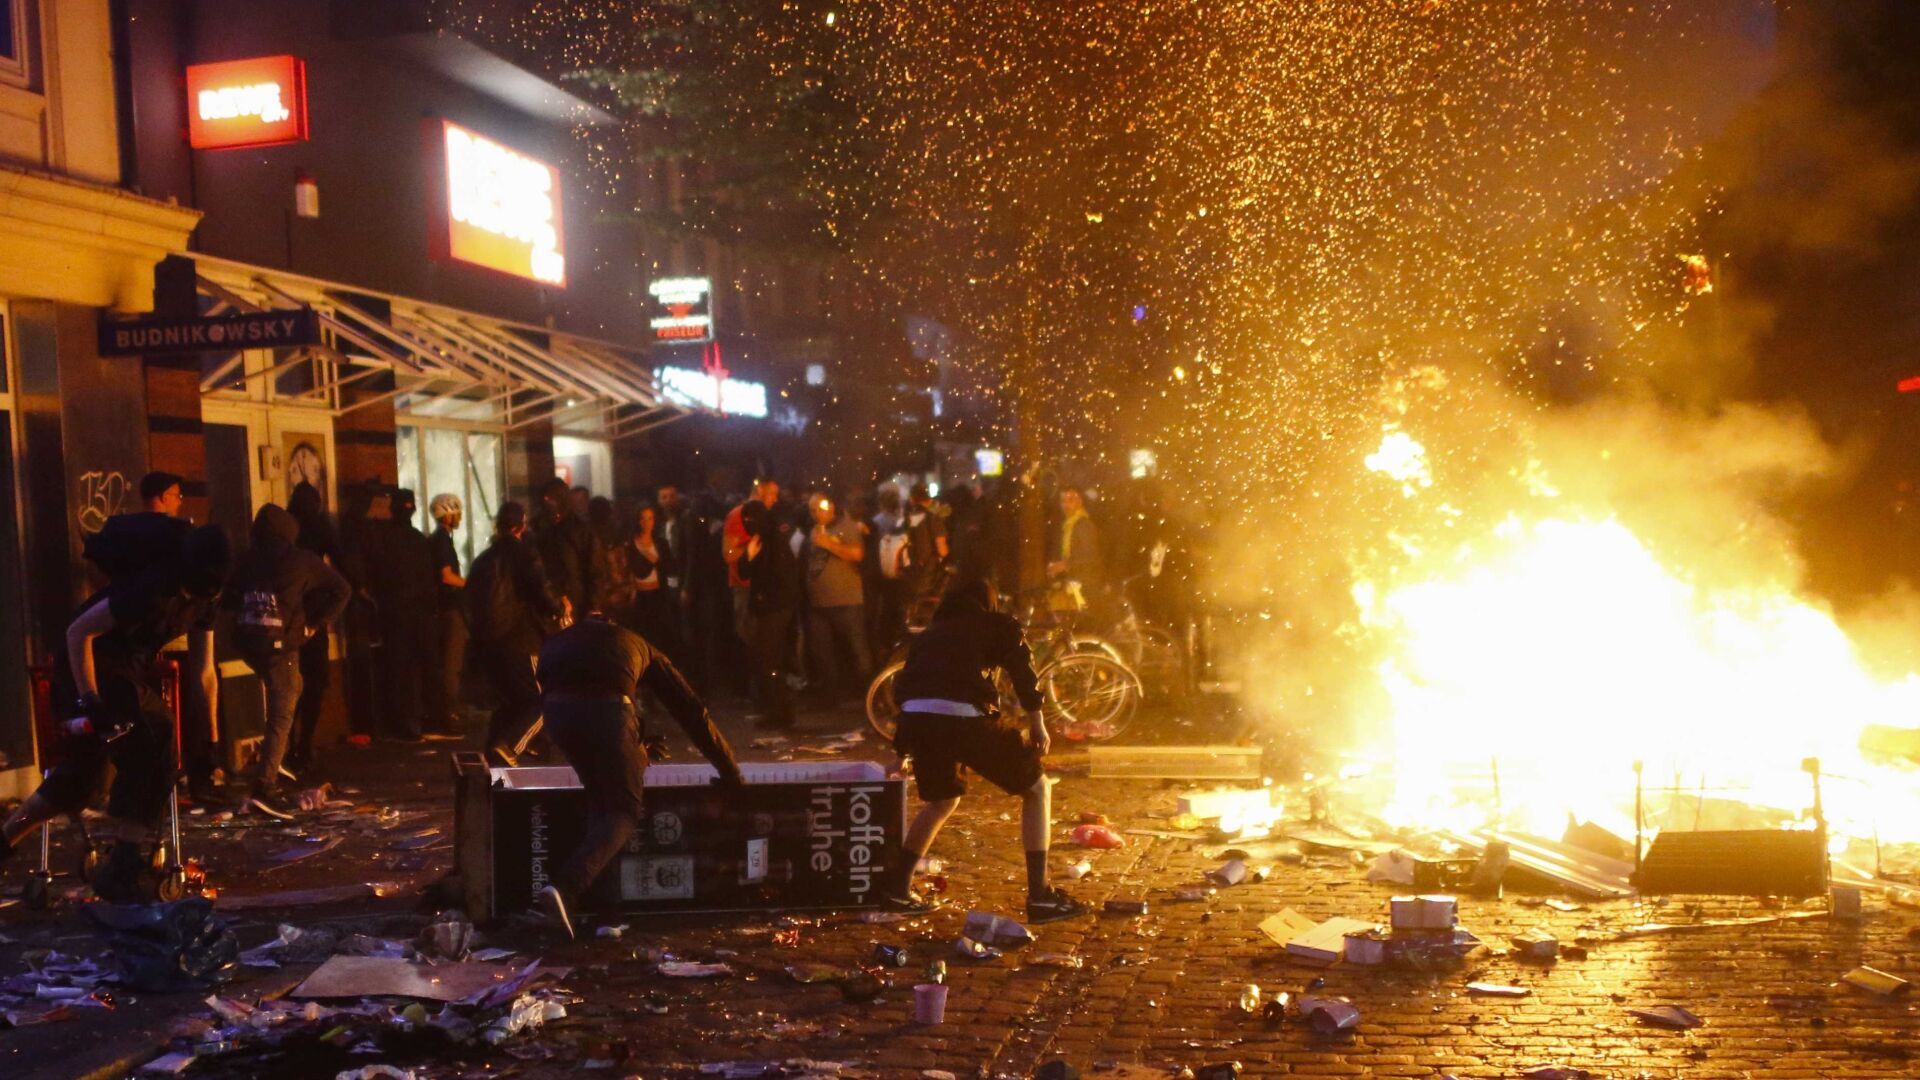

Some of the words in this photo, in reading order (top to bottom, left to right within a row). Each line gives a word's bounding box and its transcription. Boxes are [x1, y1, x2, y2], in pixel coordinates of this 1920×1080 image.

[115, 319, 296, 348] BUDNIKOWSKY
[811, 786, 846, 872] truhe
[849, 786, 885, 904] koffein-
